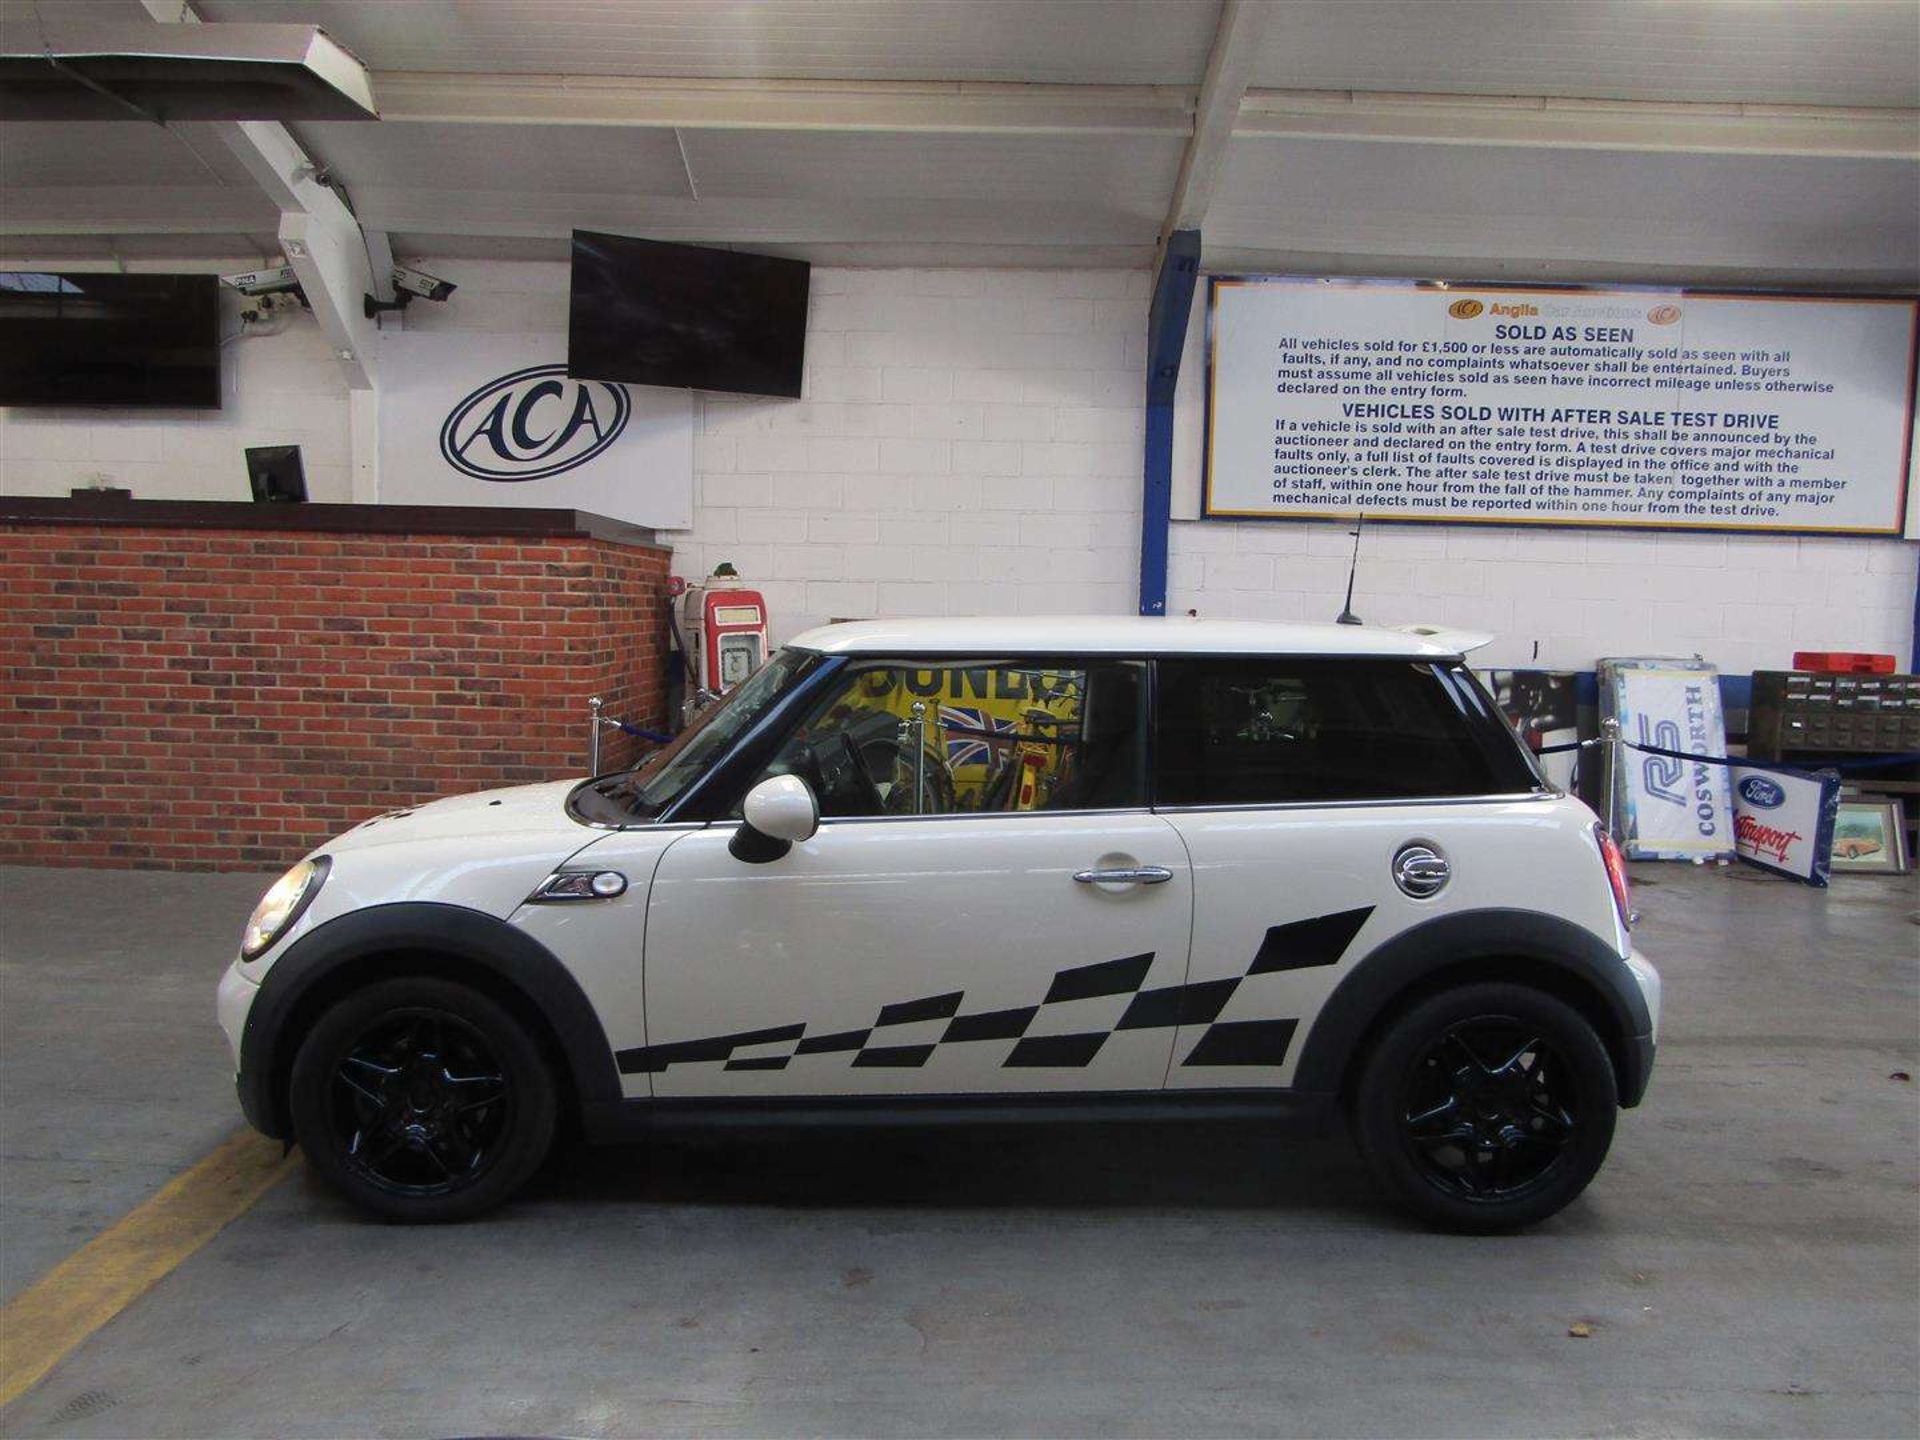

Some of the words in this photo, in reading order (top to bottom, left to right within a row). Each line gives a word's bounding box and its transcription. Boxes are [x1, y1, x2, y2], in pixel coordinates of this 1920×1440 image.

[1489, 303, 1538, 319] Anglia
[1495, 324, 1547, 339] SOLD
[1552, 325, 1577, 340] AS
[1584, 326, 1634, 341] SEEN
[1278, 337, 1297, 349] All
[1301, 338, 1360, 350] vehicles
[1364, 340, 1394, 351] sold
[1398, 340, 1418, 352] for
[1422, 341, 1468, 354] £1,500
[1471, 344, 1487, 354] or
[1490, 343, 1520, 354] less
[1523, 345, 1546, 355] are
[1550, 344, 1644, 360] automatically
[1647, 347, 1678, 359] sold
[1681, 349, 1698, 359] as
[1702, 350, 1736, 360] seen
[1740, 349, 1769, 361] with
[1773, 350, 1790, 362] all
[1282, 352, 1326, 365] faults,
[1330, 353, 1340, 364] if
[1343, 355, 1371, 368] any,
[1375, 354, 1402, 366] and
[1406, 357, 1423, 366] no
[1428, 356, 1505, 371] complaints
[1509, 358, 1590, 371] whatsoever
[1594, 360, 1627, 372] shall
[1631, 361, 1649, 372] be
[1653, 361, 1737, 375] entertained.
[1741, 364, 1790, 379] Buyers
[1277, 381, 1339, 394] declared
[1342, 385, 1360, 394] on
[1364, 384, 1386, 395] the
[1390, 384, 1427, 399] entry
[1431, 385, 1467, 397] form.
[1278, 366, 1313, 378] must
[1317, 369, 1372, 380] assume
[1376, 369, 1393, 380] all
[1396, 369, 1454, 382] vehicles
[1459, 371, 1489, 383] sold
[1492, 373, 1509, 383] as
[1513, 374, 1547, 384] seen
[1551, 373, 1584, 385] have
[1588, 374, 1651, 387] incorrect
[1655, 376, 1711, 391] mileage
[1715, 378, 1761, 390] unless
[1765, 379, 1834, 392] otherwise
[458, 380, 606, 462] ACA
[1342, 402, 1435, 419] VEHICLES
[1441, 405, 1492, 420] SOLD
[1497, 406, 1545, 421] WITH
[1550, 408, 1611, 423] AFTER
[1617, 409, 1666, 425] SALE
[1670, 411, 1718, 426] TEST
[1723, 412, 1779, 428] DRIVE
[1276, 419, 1285, 430] If
[1289, 421, 1297, 430] a
[1301, 419, 1351, 432] vehicle
[1355, 421, 1367, 432] is
[1372, 421, 1402, 433] sold
[1406, 422, 1435, 434] with
[1439, 425, 1456, 434] an
[1460, 423, 1493, 435] after
[1497, 424, 1526, 436] sale
[1529, 425, 1556, 437] test
[1560, 426, 1599, 439] drive,
[1603, 427, 1630, 439] this
[1634, 428, 1667, 440] shall
[1671, 429, 1689, 440] be
[1692, 430, 1770, 443] announced
[1774, 432, 1791, 446] by
[1795, 432, 1817, 444] the
[1274, 448, 1313, 460] faults
[1317, 449, 1350, 463] only,
[1354, 451, 1363, 461] a
[1366, 450, 1389, 462] full
[1393, 451, 1414, 462] list
[1418, 451, 1433, 463] of
[1436, 452, 1475, 464] faults
[1479, 453, 1535, 465] covered
[1539, 455, 1551, 466] is
[1555, 455, 1623, 470] displayed
[1627, 457, 1640, 468] in
[1644, 457, 1666, 469] the
[1670, 458, 1710, 470] office
[1714, 459, 1740, 471] and
[1744, 460, 1773, 472] with
[1777, 461, 1799, 472] the
[1275, 434, 1350, 447] auctioneer
[1353, 436, 1379, 447] and
[1383, 437, 1445, 449] declared
[1448, 440, 1466, 449] on
[1469, 439, 1492, 450] the
[1495, 439, 1532, 454] entry
[1535, 440, 1572, 452] form.
[1576, 441, 1586, 453] A
[1590, 442, 1617, 453] test
[1621, 443, 1656, 454] drive
[1660, 445, 1707, 456] covers
[1711, 445, 1751, 460] major
[1755, 446, 1835, 459] mechanical
[1273, 462, 1358, 475] auctioneer's
[1362, 464, 1401, 476] clerk.
[1406, 466, 1431, 477] The
[1435, 466, 1468, 478] after
[1472, 467, 1500, 479] sale
[1504, 468, 1531, 480] test
[1534, 469, 1570, 481] drive
[1574, 470, 1609, 482] must
[1613, 471, 1630, 482] be
[1634, 472, 1674, 483] taken
[1681, 473, 1740, 488] together
[1744, 474, 1773, 486] with
[1777, 477, 1785, 486] a
[1789, 476, 1847, 488] member
[1273, 477, 1287, 488] of
[1291, 477, 1326, 490] staff,
[1330, 478, 1372, 490] within
[1376, 481, 1402, 491] one
[1406, 480, 1439, 492] hour
[1442, 481, 1475, 493] from
[1478, 482, 1501, 493] the
[1504, 483, 1526, 494] fall
[1529, 483, 1544, 495] of
[1548, 484, 1570, 495] the
[1574, 484, 1633, 497] hammer.
[1637, 486, 1664, 500] Any
[1668, 487, 1745, 503] complaints
[1748, 489, 1763, 500] of
[1766, 491, 1791, 504] any
[1795, 490, 1835, 505] major
[1273, 492, 1352, 505] mechanical
[1355, 494, 1408, 506] defects
[1412, 495, 1447, 507] must
[1451, 496, 1468, 508] be
[1472, 497, 1532, 512] reported
[1535, 498, 1578, 510] within
[1582, 501, 1607, 511] one
[1612, 500, 1644, 512] hour
[1647, 501, 1680, 513] from
[1684, 502, 1706, 514] the
[1710, 503, 1737, 515] test
[1740, 504, 1779, 516] drive.
[1638, 712, 1688, 808] RS
